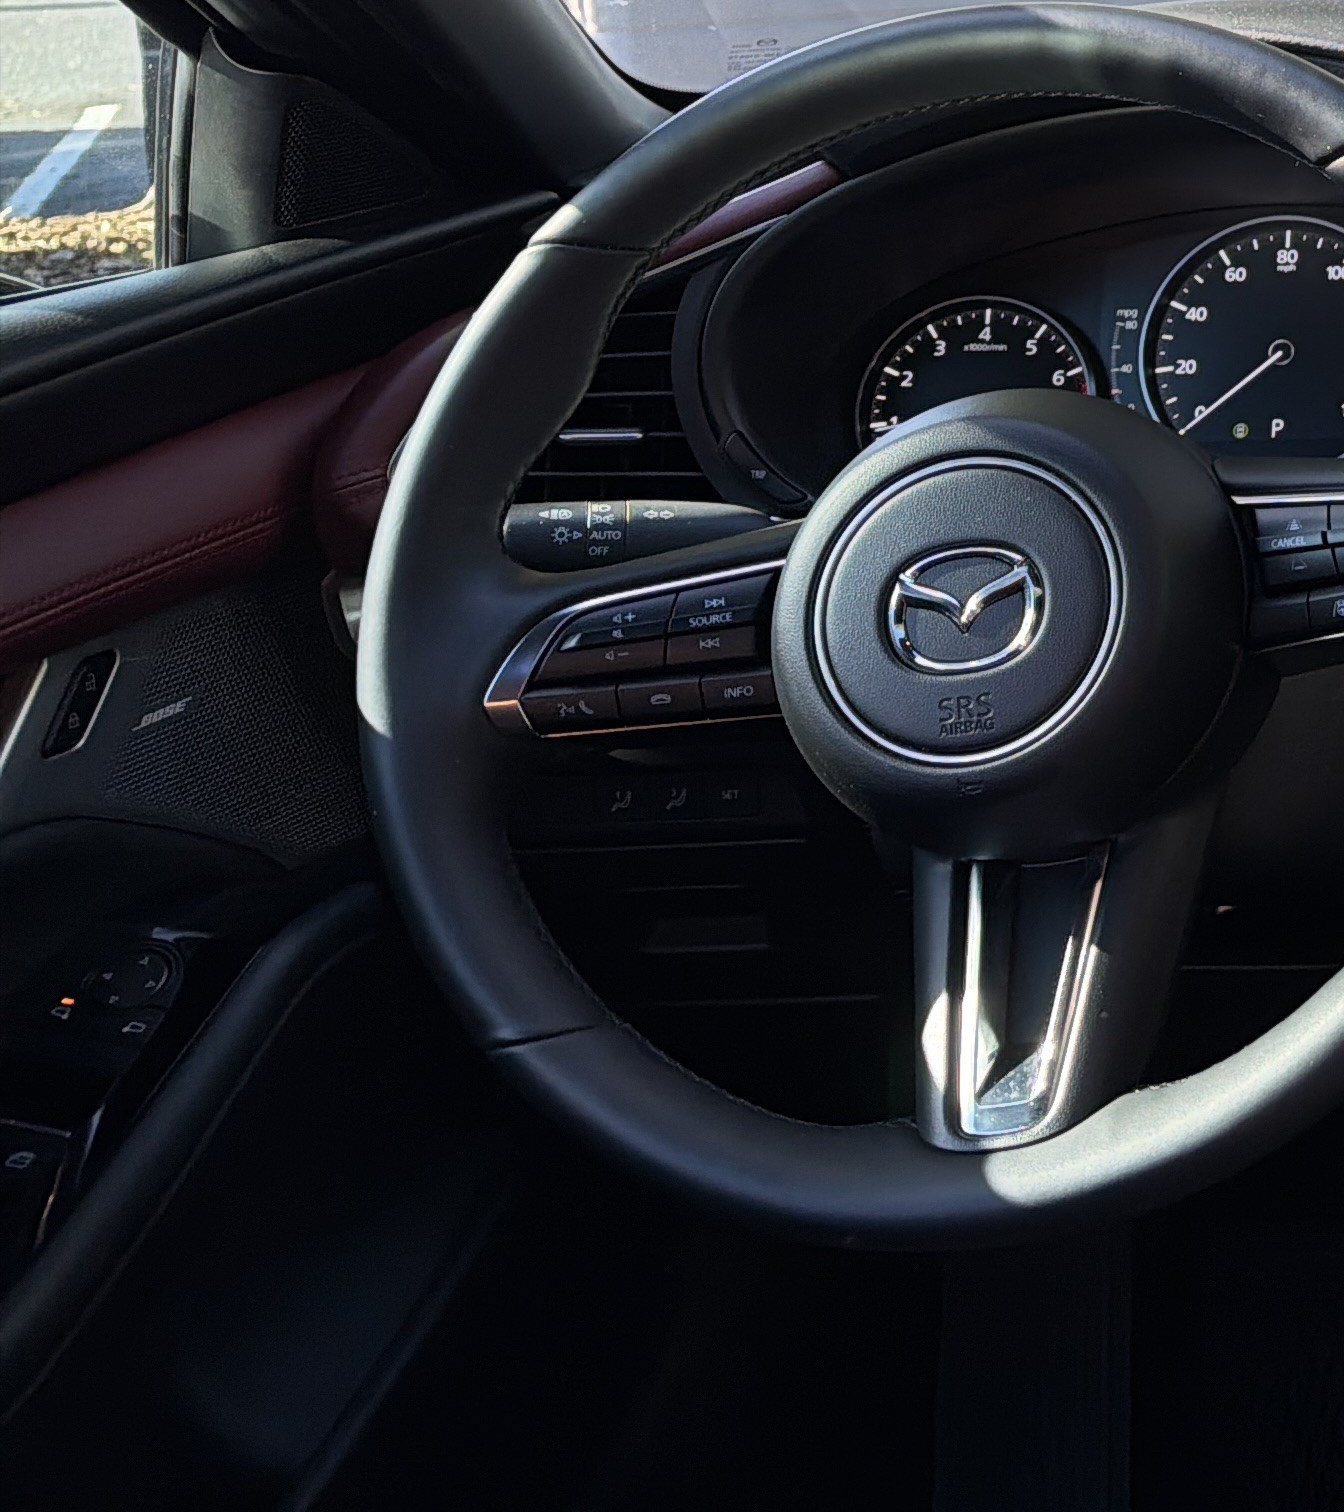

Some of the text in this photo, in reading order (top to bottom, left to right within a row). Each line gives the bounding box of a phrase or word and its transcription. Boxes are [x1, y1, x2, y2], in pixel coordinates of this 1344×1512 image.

[1276, 249, 1300, 264] 80
[1224, 266, 1247, 283] 60
[1116, 308, 1139, 320] mpg
[1184, 306, 1208, 323] 40
[977, 326, 993, 342] 4
[932, 340, 947, 356] 3
[1024, 339, 1039, 356] 5
[1175, 358, 1197, 375] 20
[900, 370, 914, 388] 2
[1051, 369, 1065, 387] 6
[1271, 418, 1286, 439] P
[590, 530, 622, 540] AUTO
[1271, 536, 1307, 549] CANCEL
[588, 546, 610, 556] OFF
[689, 612, 733, 628] SOURCE
[724, 685, 754, 698] INFO
[131, 696, 193, 732] BOSE
[937, 691, 993, 723] SRS
[939, 718, 996, 738] AIRBAG
